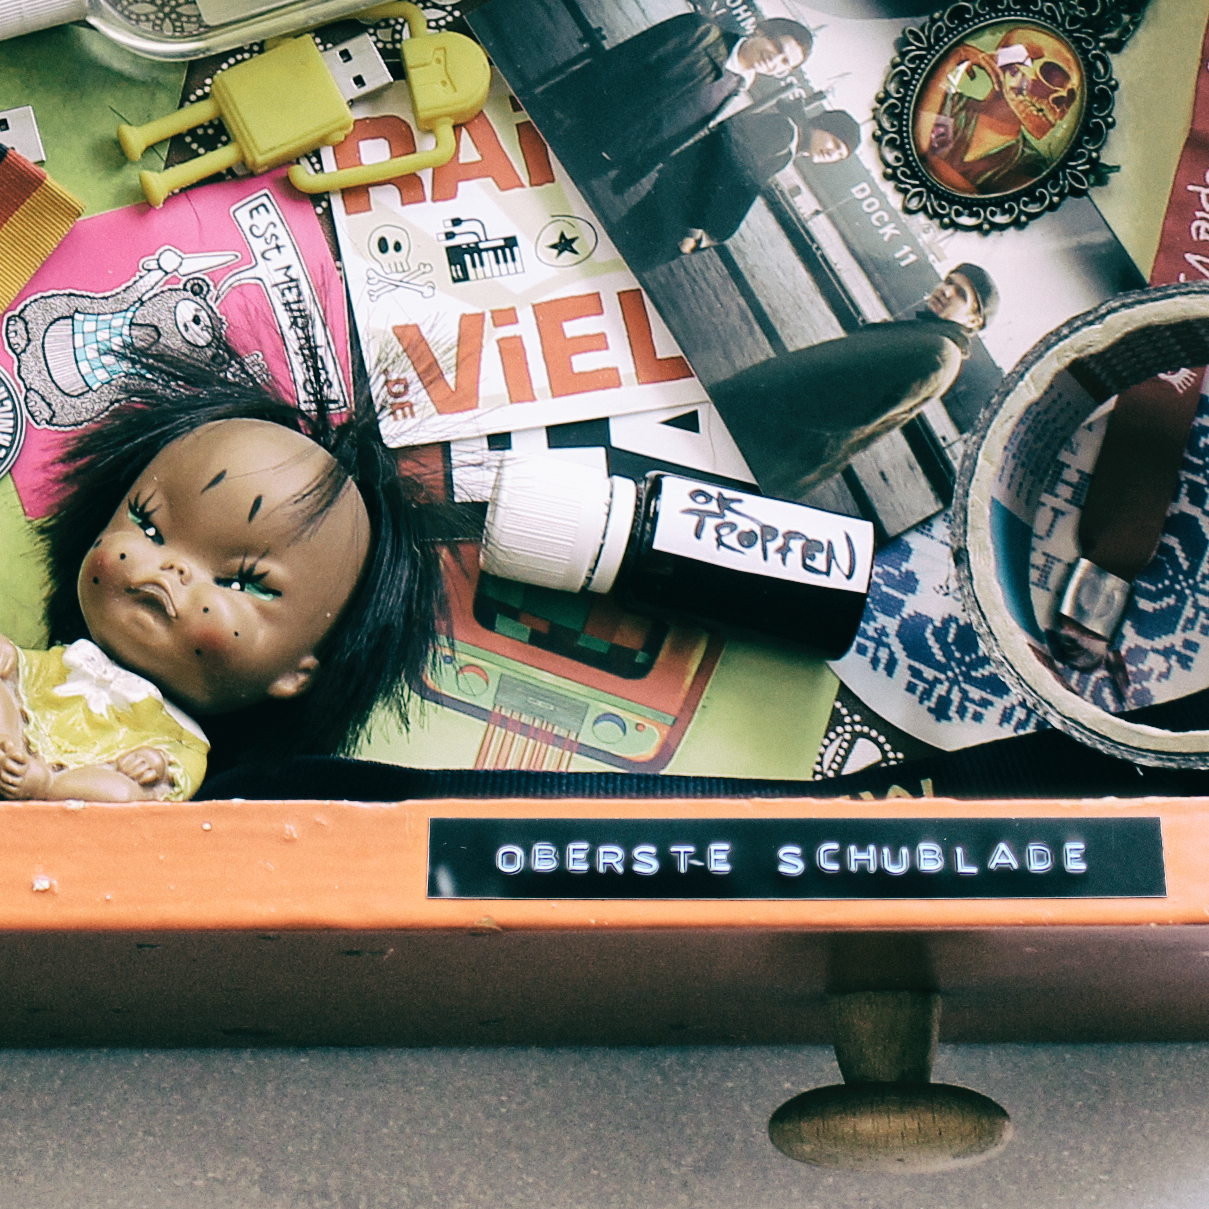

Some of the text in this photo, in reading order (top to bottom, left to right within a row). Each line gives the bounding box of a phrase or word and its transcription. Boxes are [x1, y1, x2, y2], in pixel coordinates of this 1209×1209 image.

[850, 181, 921, 269] DOCK 11
[686, 487, 745, 518] OK
[672, 505, 861, 581] TROPFEN
[495, 840, 1089, 878] OBERSTE SCHUBLADE
